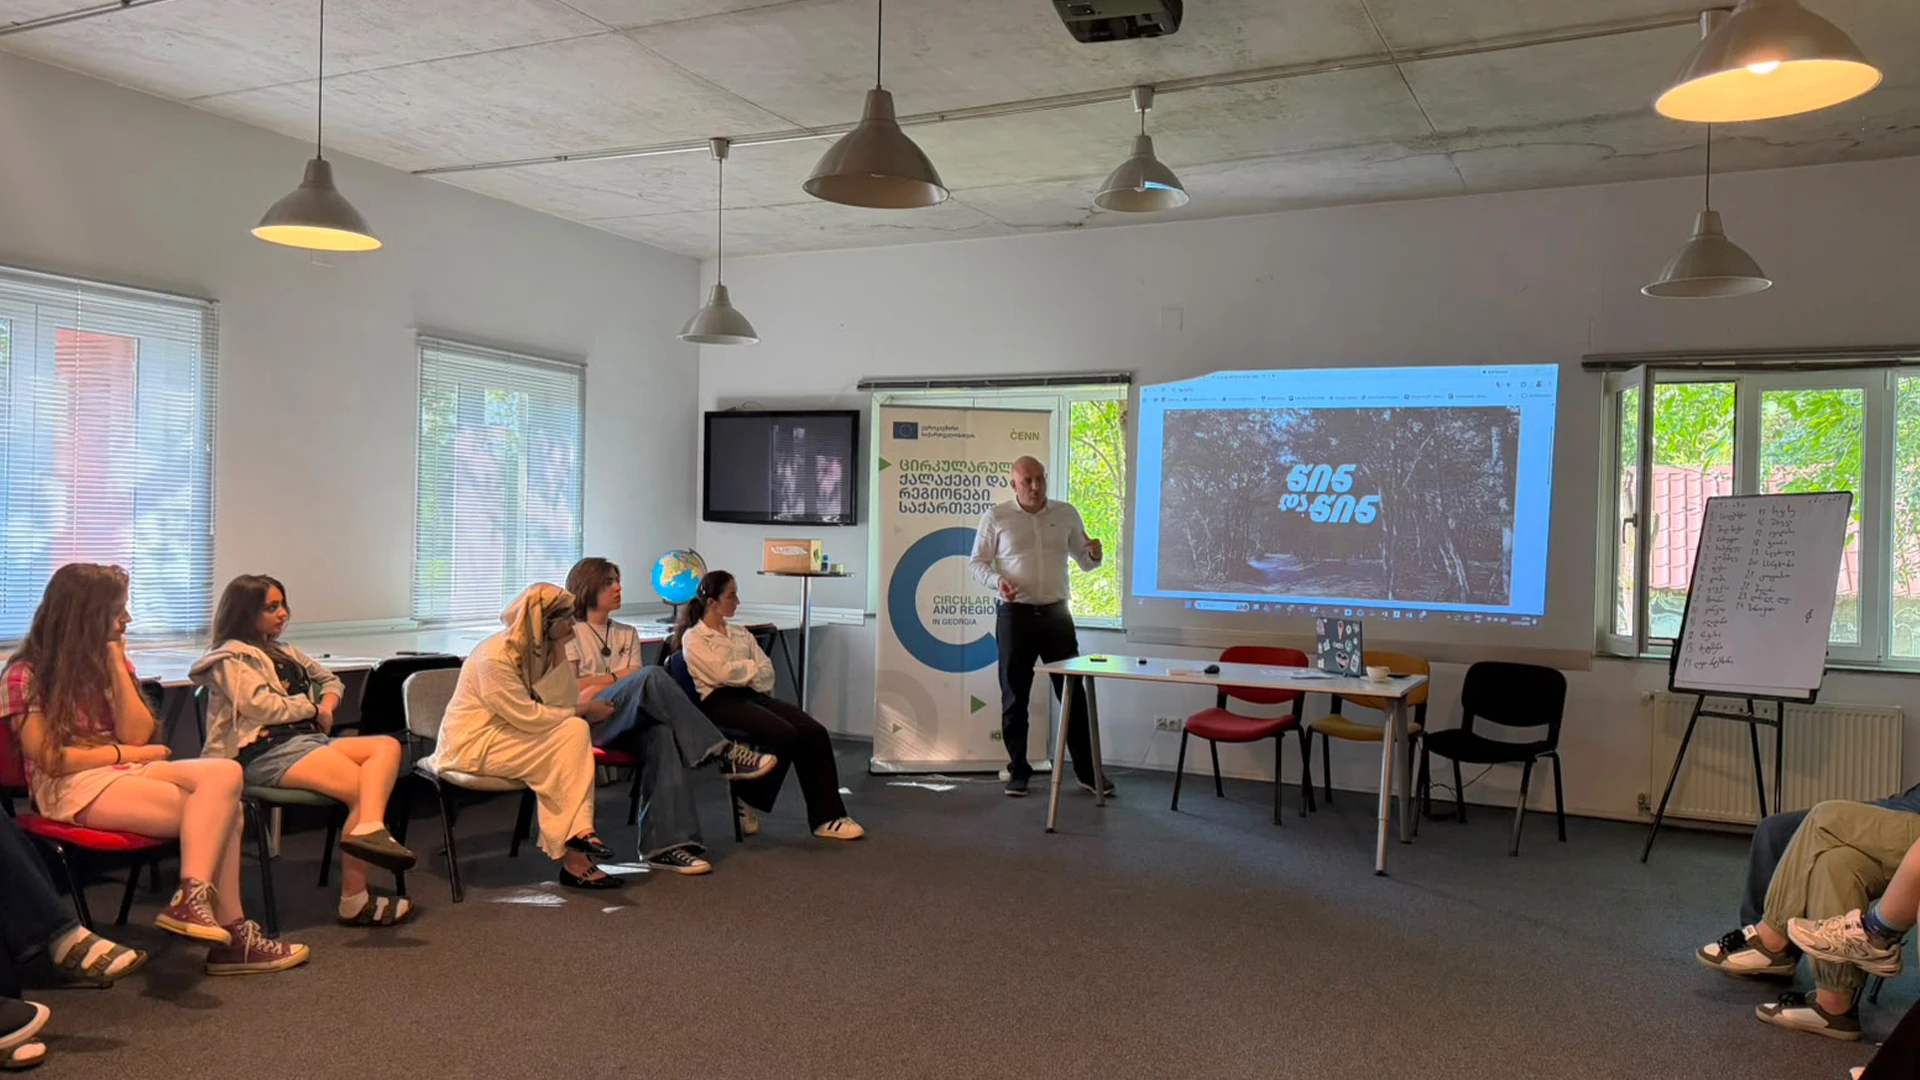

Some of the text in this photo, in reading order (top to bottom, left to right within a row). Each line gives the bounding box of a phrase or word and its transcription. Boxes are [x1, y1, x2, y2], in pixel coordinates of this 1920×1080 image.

[899, 458, 1014, 474] ცირკულარულ
[899, 473, 1009, 488] ქალაქები და
[899, 487, 991, 501] რეგიონები
[899, 501, 997, 514] საქართველ
[933, 595, 990, 605] CIRCULAR
[933, 605, 997, 615] AND REGIO
